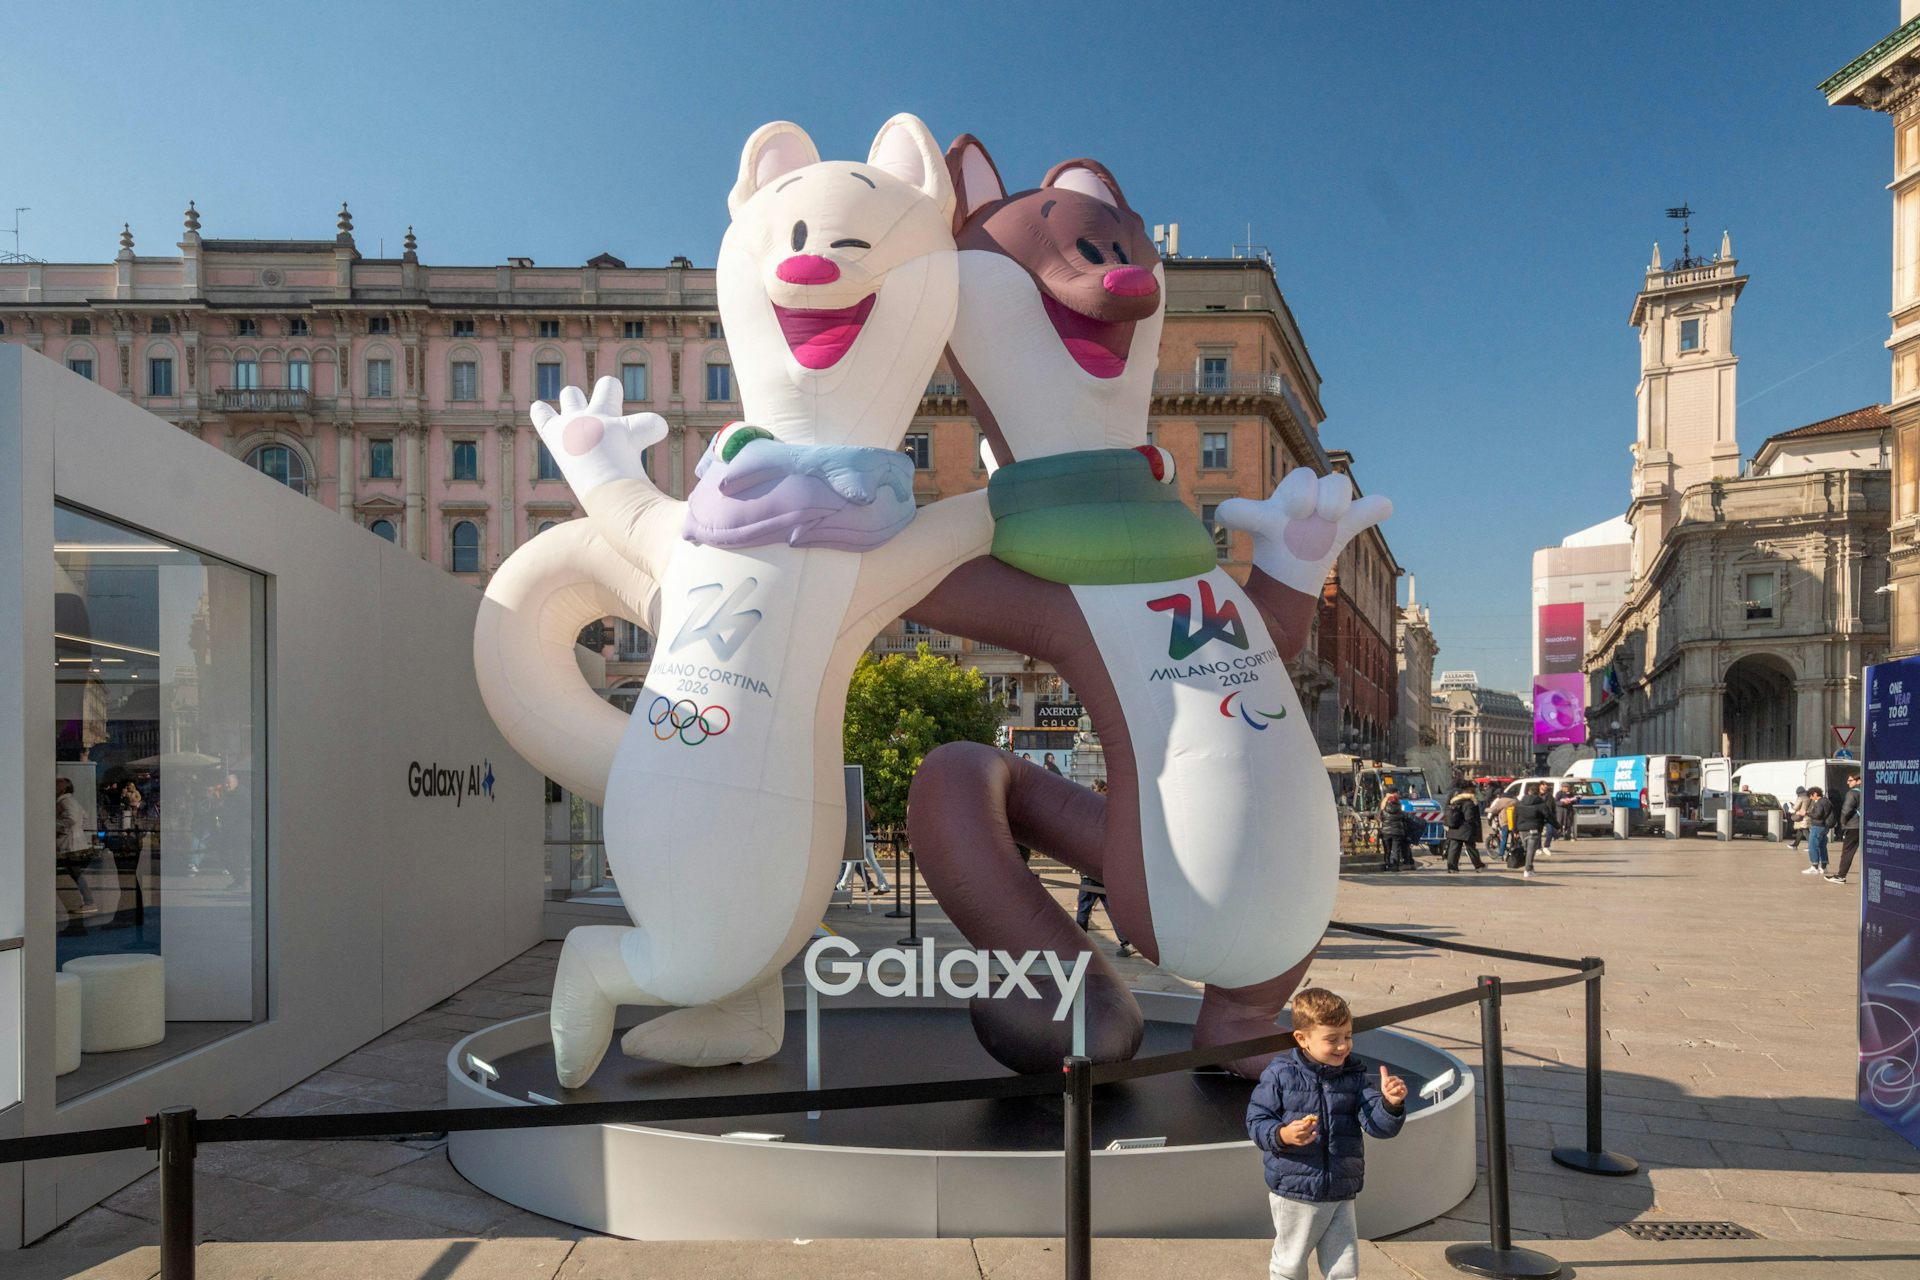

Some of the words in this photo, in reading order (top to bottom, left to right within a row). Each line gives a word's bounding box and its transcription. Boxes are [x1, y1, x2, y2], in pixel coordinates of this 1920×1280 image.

[1150, 661, 1230, 681] MILANO
[1233, 647, 1279, 670] CORTIN
[652, 663, 695, 677] MILANO
[698, 666, 772, 698] CORTINA
[1218, 670, 1259, 687] 2026
[676, 679, 709, 696] 2026
[1889, 681, 1903, 695] ONE
[1894, 692, 1911, 705] YEAR
[1039, 707, 1078, 716] AXERTA
[1888, 706, 1897, 718] TO
[1897, 705, 1908, 718] GO
[1041, 719, 1076, 727] CALO
[1868, 761, 1886, 770] MILANO
[1886, 760, 1906, 770] CORTINA
[1906, 759, 1920, 769] 2026
[408, 761, 464, 808] Galaxy
[467, 764, 480, 796] AI
[1875, 771, 1898, 784] SPORT
[1899, 771, 1920, 784] VILLA
[804, 935, 1093, 1021] Galaxy
